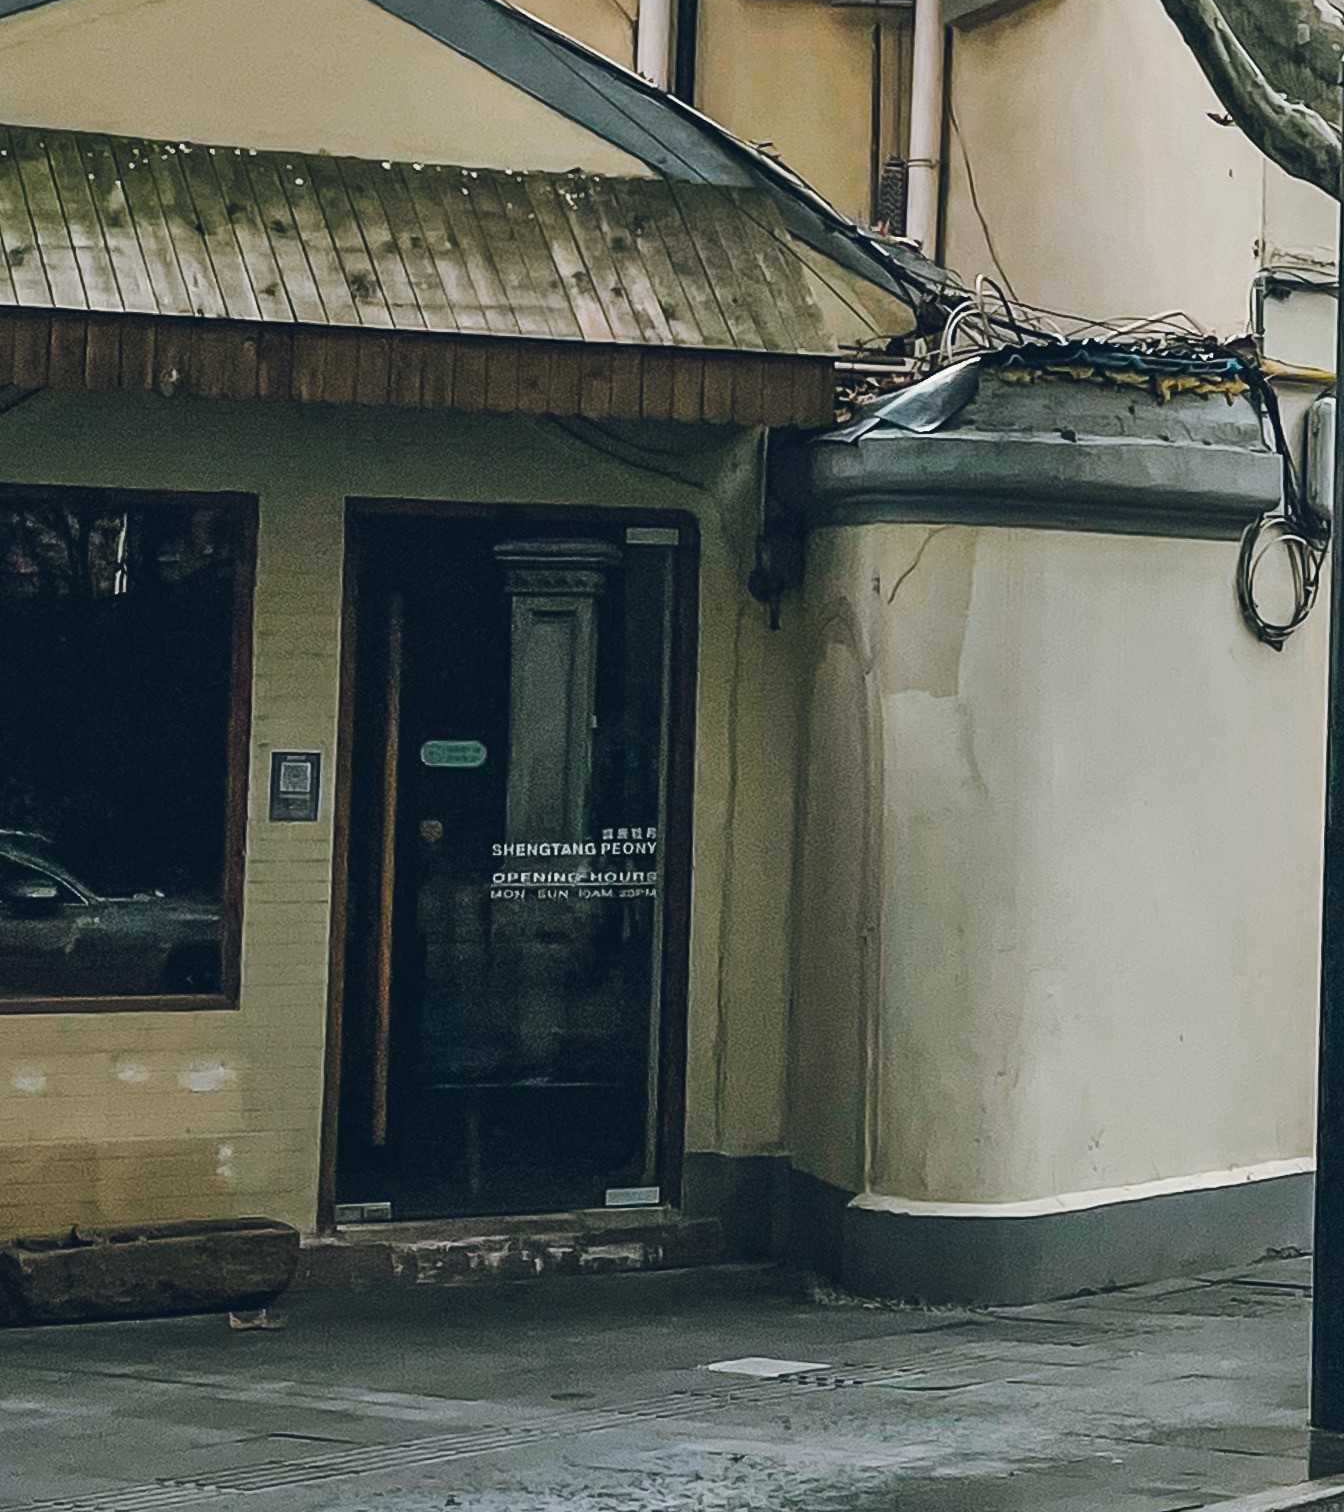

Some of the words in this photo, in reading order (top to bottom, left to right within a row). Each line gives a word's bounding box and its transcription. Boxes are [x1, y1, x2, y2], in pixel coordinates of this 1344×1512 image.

[492, 842, 597, 856] SHENGTANG
[601, 841, 657, 856] PEONY
[492, 872, 583, 884] OPENING
[590, 871, 657, 883] HOURS
